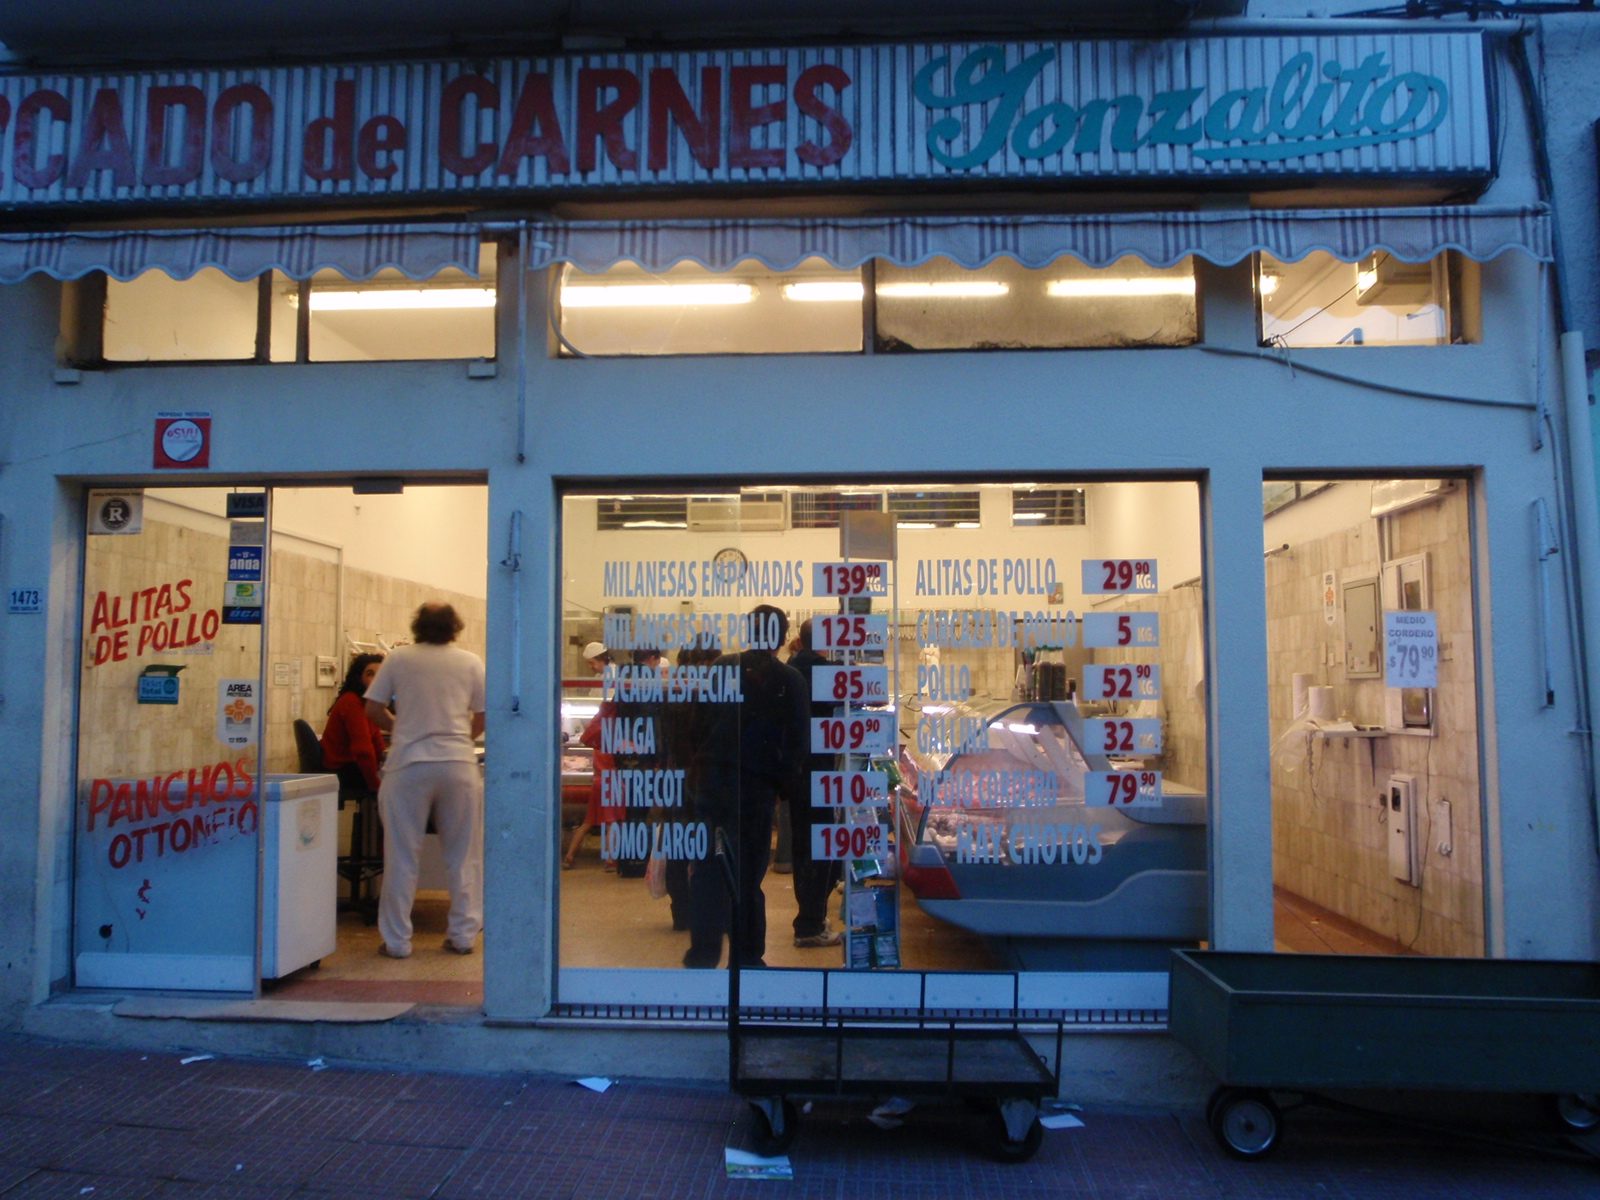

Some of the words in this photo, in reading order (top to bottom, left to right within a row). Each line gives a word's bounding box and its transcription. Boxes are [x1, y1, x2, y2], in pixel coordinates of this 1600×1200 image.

[0, 82, 272, 191] CADO
[303, 80, 408, 182] de
[438, 62, 853, 177] CARNES
[912, 44, 1449, 170] Gonzalito
[230, 559, 260, 570] anda
[603, 560, 697, 597] MILANESAS
[702, 560, 804, 597] EMPANADAS
[915, 559, 972, 596] ALITAS
[976, 559, 998, 596] DE
[1003, 558, 1057, 596] POLLO
[11, 590, 39, 605] 1473
[90, 579, 193, 634] ALITAS
[94, 630, 129, 667] DE
[136, 608, 220, 657] POLLO
[604, 612, 698, 650] MILANESAS
[701, 613, 722, 650] DE
[727, 612, 780, 650] POLLO
[822, 617, 866, 647] 125
[998, 611, 1018, 648] DE
[1024, 610, 1077, 648] POLLO
[1117, 615, 1132, 646] 5
[1388, 629, 1434, 638] CORDERO
[1396, 616, 1426, 625] MEDIO
[227, 684, 252, 692] AREA
[603, 665, 663, 702] PICADA
[668, 665, 744, 702] ESPECIAL
[832, 670, 864, 699] 85
[917, 664, 971, 701] POLLO
[601, 717, 656, 755] NALGA
[917, 717, 991, 754] GALLINA
[1103, 721, 1134, 751] 32
[87, 757, 254, 832] PANCHOS
[601, 769, 685, 807] ENTRECOT
[820, 774, 866, 805] 110
[601, 822, 648, 860] LOMO
[652, 822, 708, 860] LARGO
[1008, 825, 1103, 865] CHOTOS
